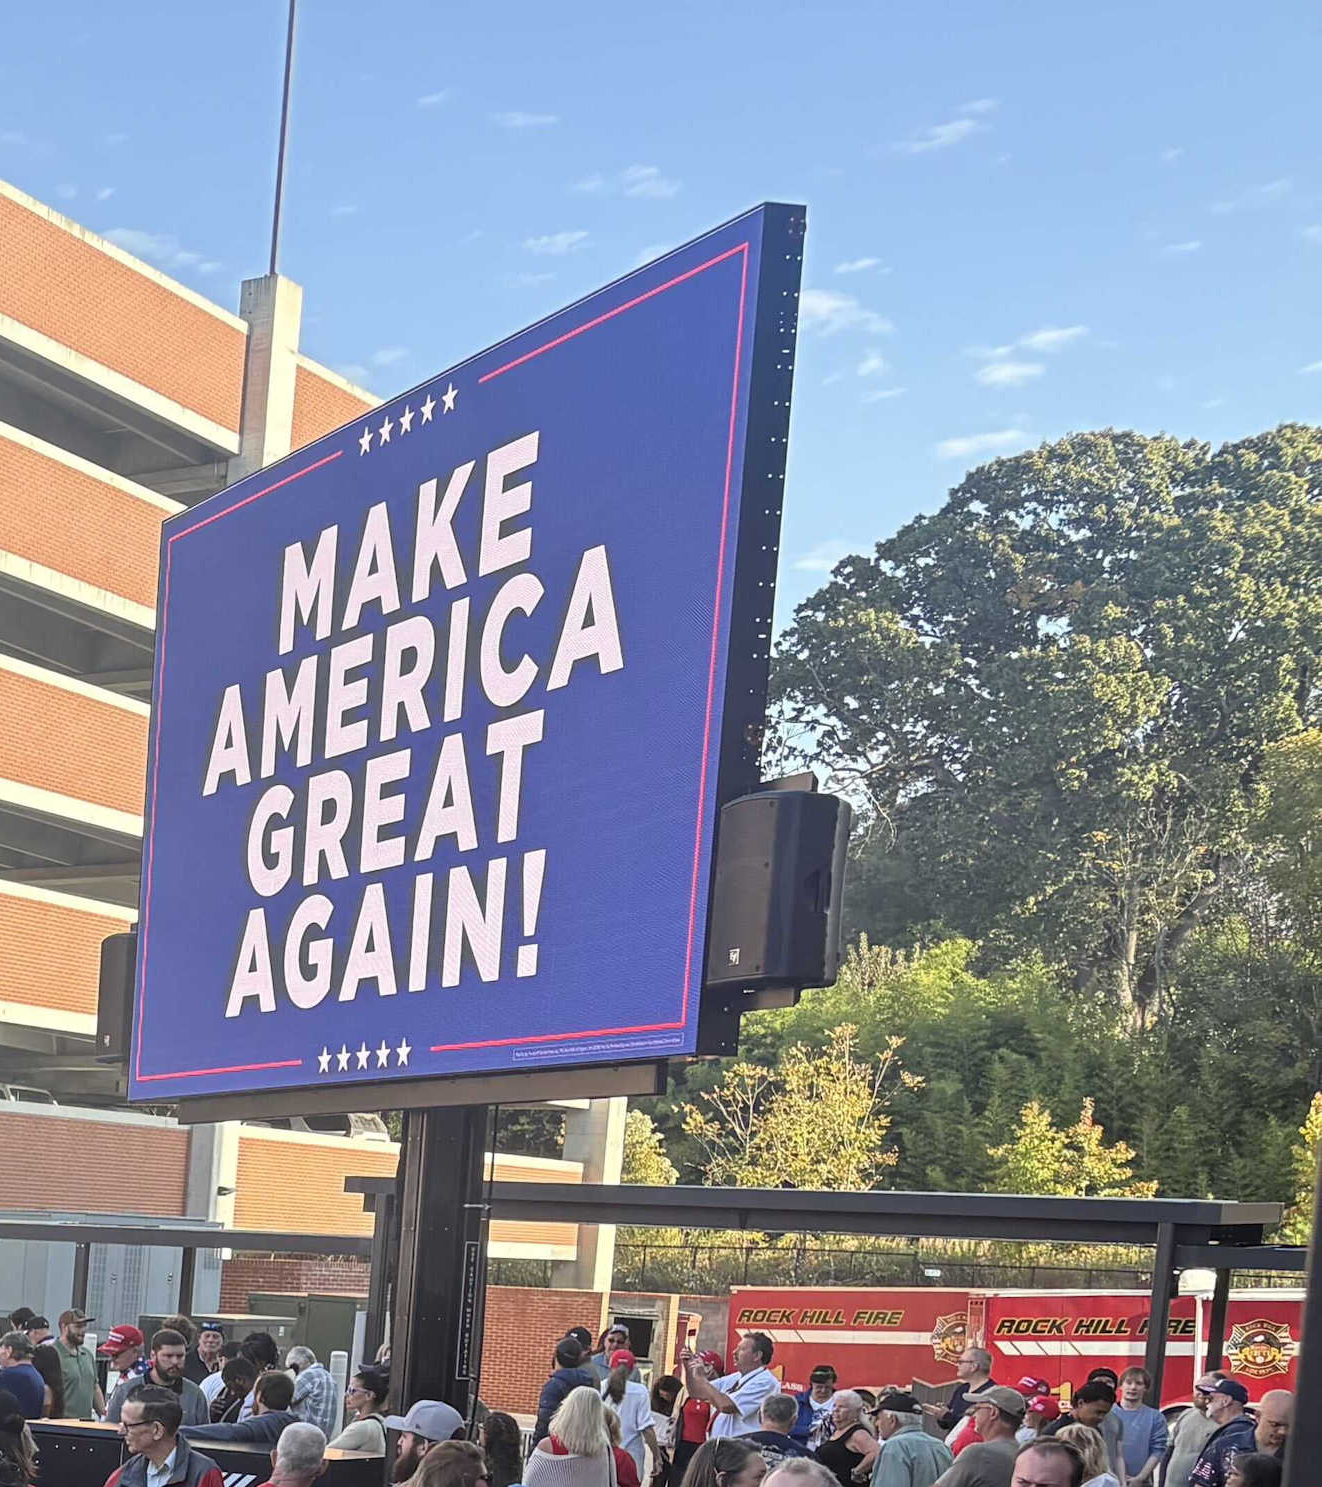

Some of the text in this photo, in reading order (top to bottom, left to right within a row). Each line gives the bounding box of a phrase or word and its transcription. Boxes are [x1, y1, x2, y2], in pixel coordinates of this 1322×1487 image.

[279, 431, 540, 655] MAKE
[202, 543, 625, 797] AMERICA
[247, 709, 545, 898] GREAT
[225, 849, 549, 1019] AGAIN!
[736, 1308, 905, 1327] ROCK HILL FIRE
[994, 1317, 1070, 1337] ROCK
[1071, 1317, 1132, 1337] HILL
